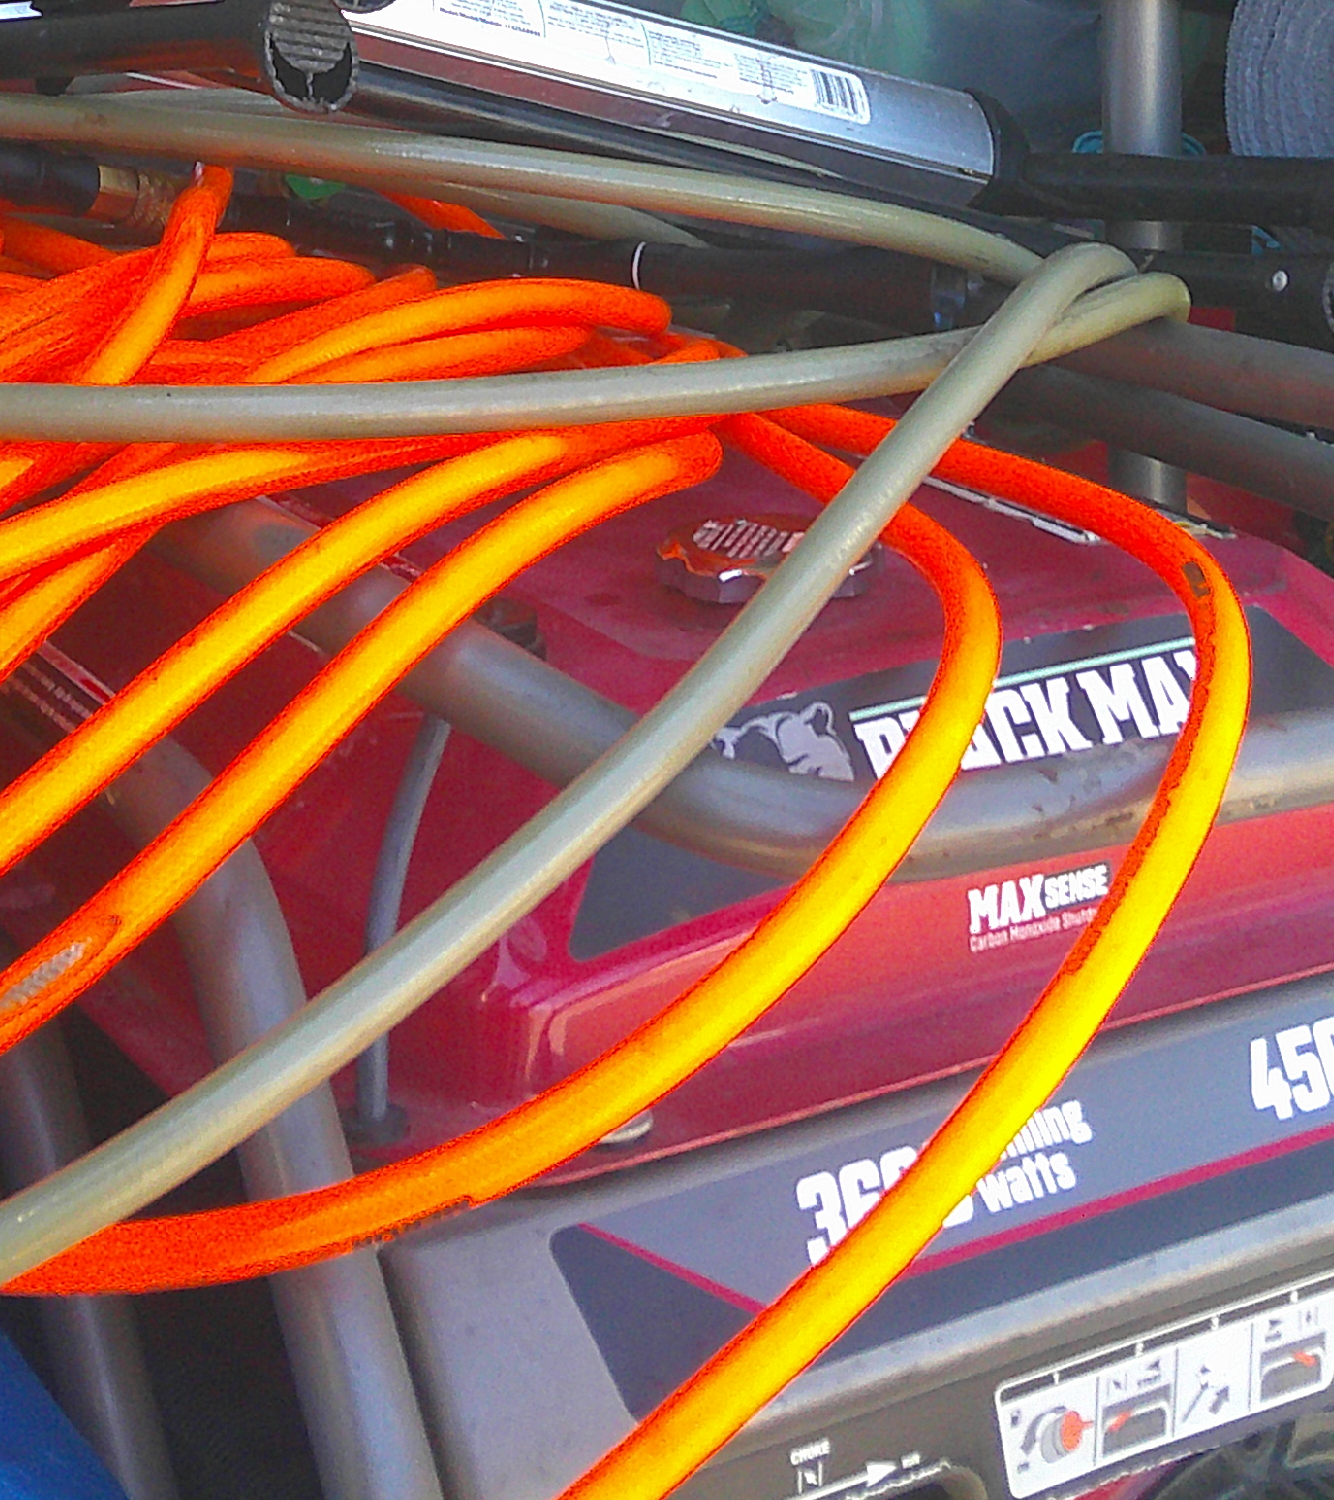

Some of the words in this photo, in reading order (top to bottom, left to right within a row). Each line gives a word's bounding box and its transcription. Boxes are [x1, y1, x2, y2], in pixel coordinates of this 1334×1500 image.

[853, 676, 1095, 782] BACK
[967, 873, 1047, 935] MAX
[1044, 863, 1110, 910] SENSE
[969, 928, 1009, 954] Carbon
[1009, 914, 1062, 943] Monoxide
[975, 1151, 1077, 1214] watts
